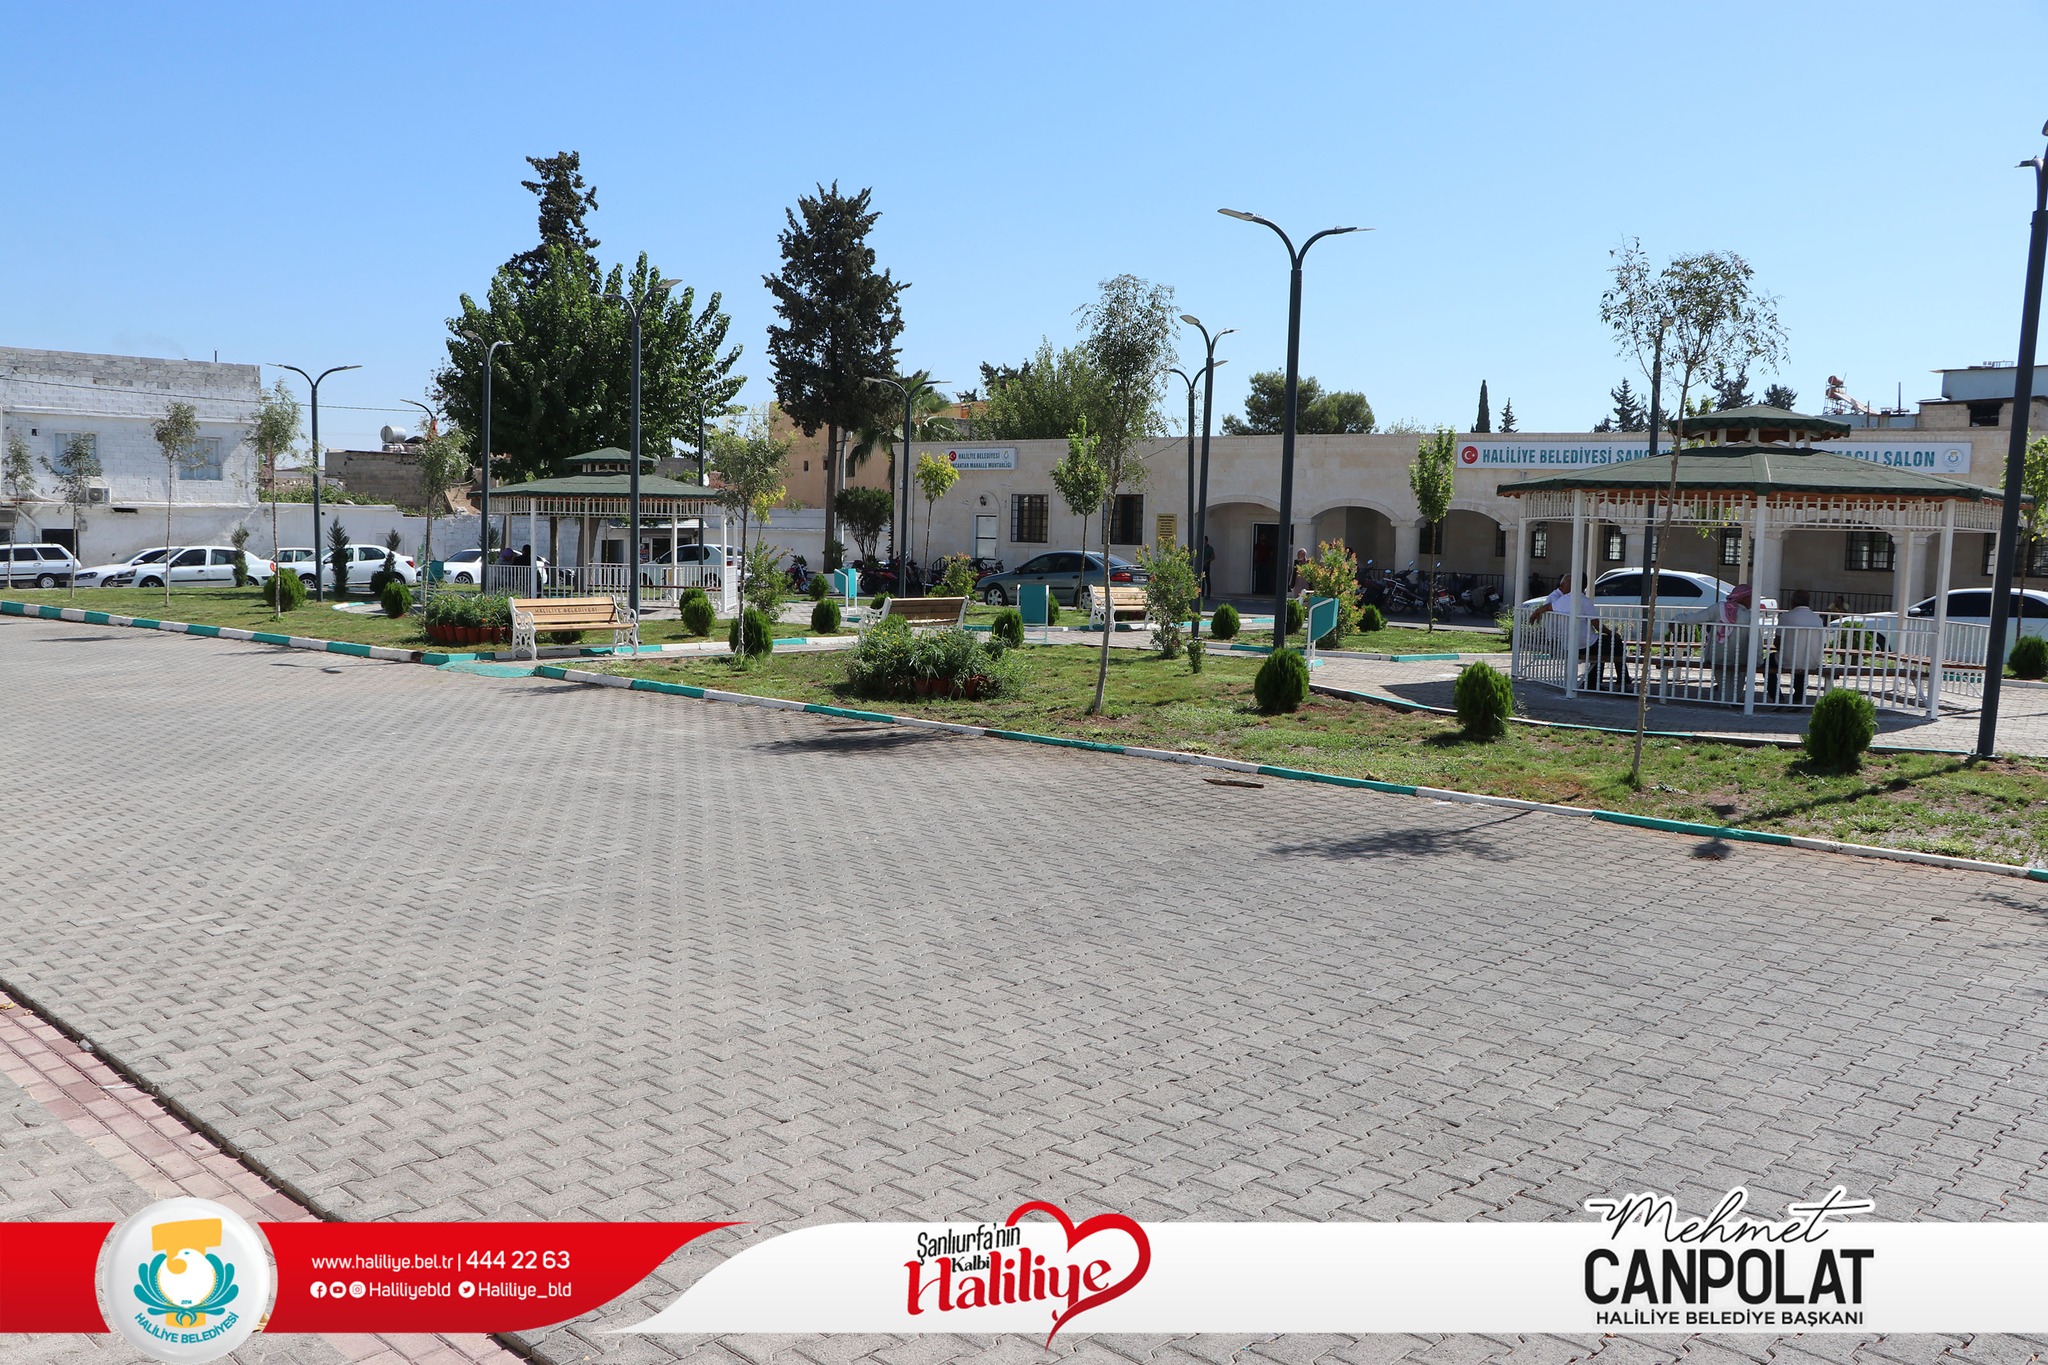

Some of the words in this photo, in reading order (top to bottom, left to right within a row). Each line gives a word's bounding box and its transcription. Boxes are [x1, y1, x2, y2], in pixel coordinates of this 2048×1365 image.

[1483, 447, 1535, 464] HALİLİYE
[1540, 447, 1612, 464] BELEDİYESİ
[1883, 451, 1935, 467] SALON
